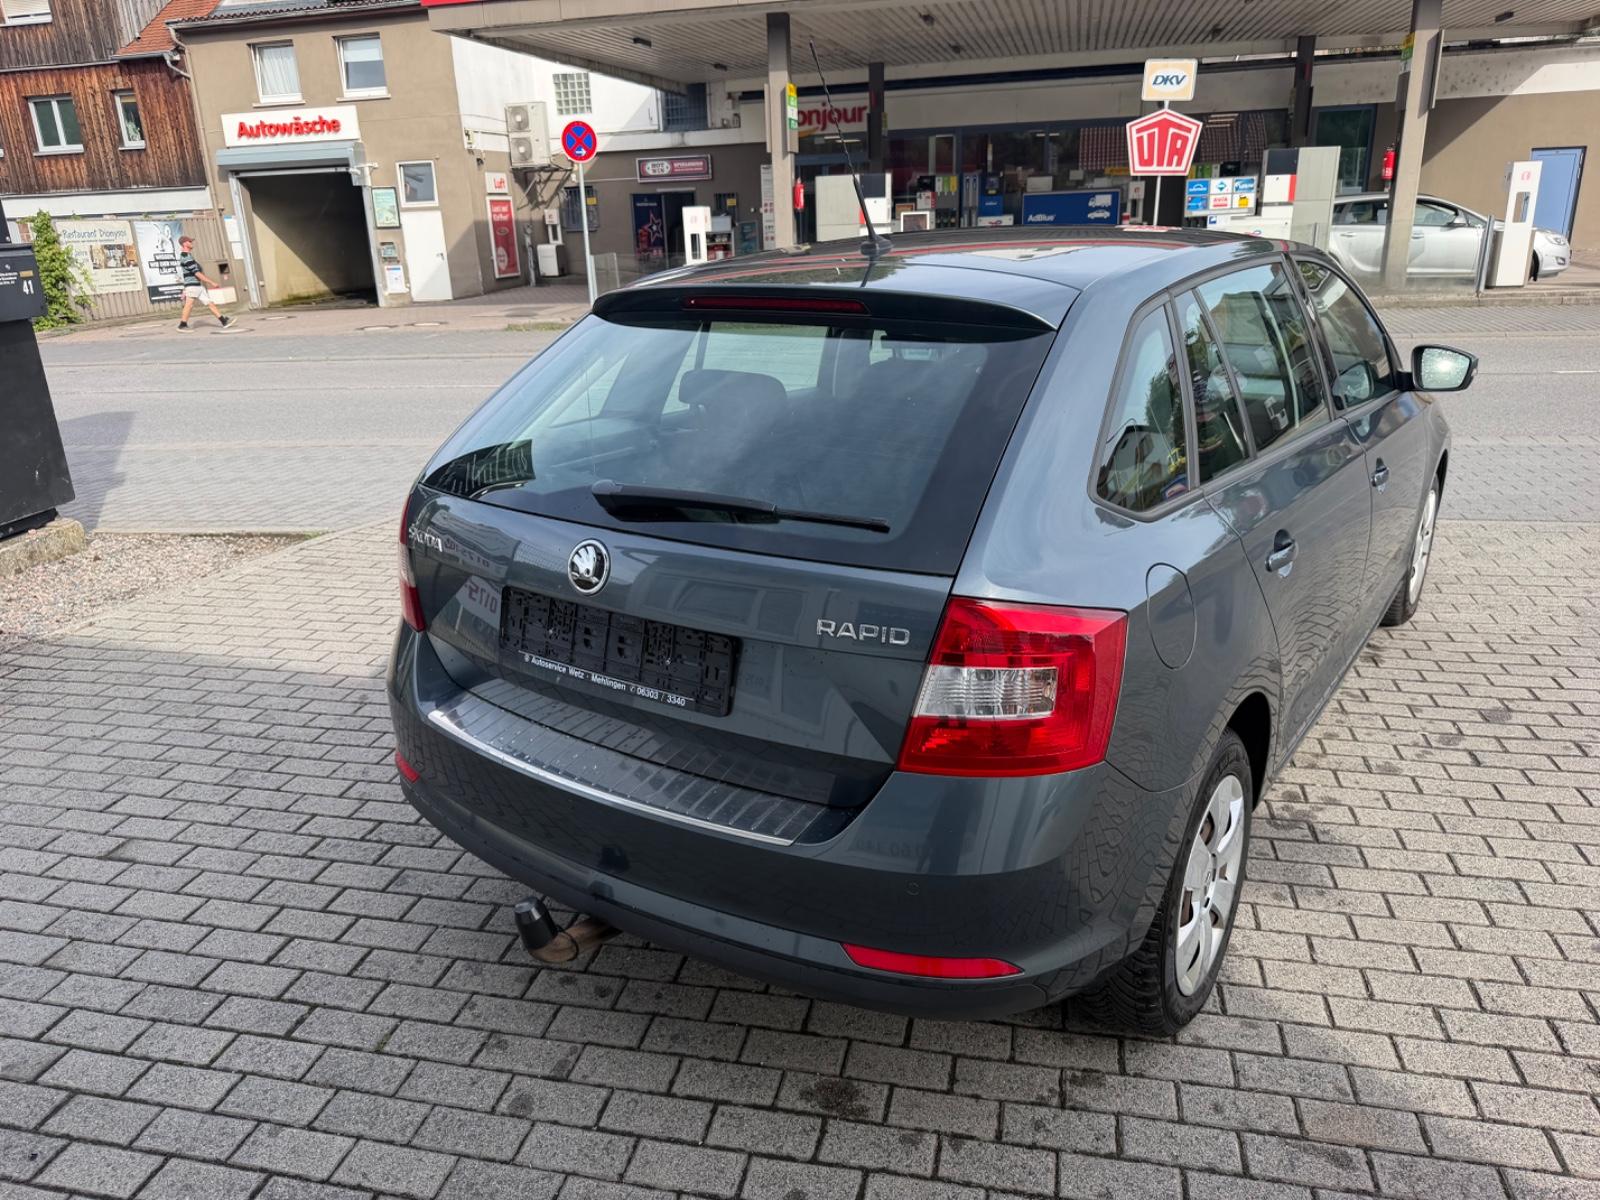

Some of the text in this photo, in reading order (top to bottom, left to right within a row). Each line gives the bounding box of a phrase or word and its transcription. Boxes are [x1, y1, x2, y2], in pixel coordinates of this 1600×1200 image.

[1152, 74, 1186, 86] DKV
[237, 115, 342, 139] Autowäsche
[797, 101, 868, 131] onjour
[1135, 117, 1192, 167] UTA
[62, 228, 97, 239] Restaurant
[23, 279, 34, 295] 41
[816, 618, 911, 645] RAPID
[531, 656, 567, 674] Autoservice
[568, 667, 585, 679] Wetz
[591, 673, 626, 691] Mehlingen
[636, 687, 659, 700] 06303
[666, 695, 686, 707] 3340
